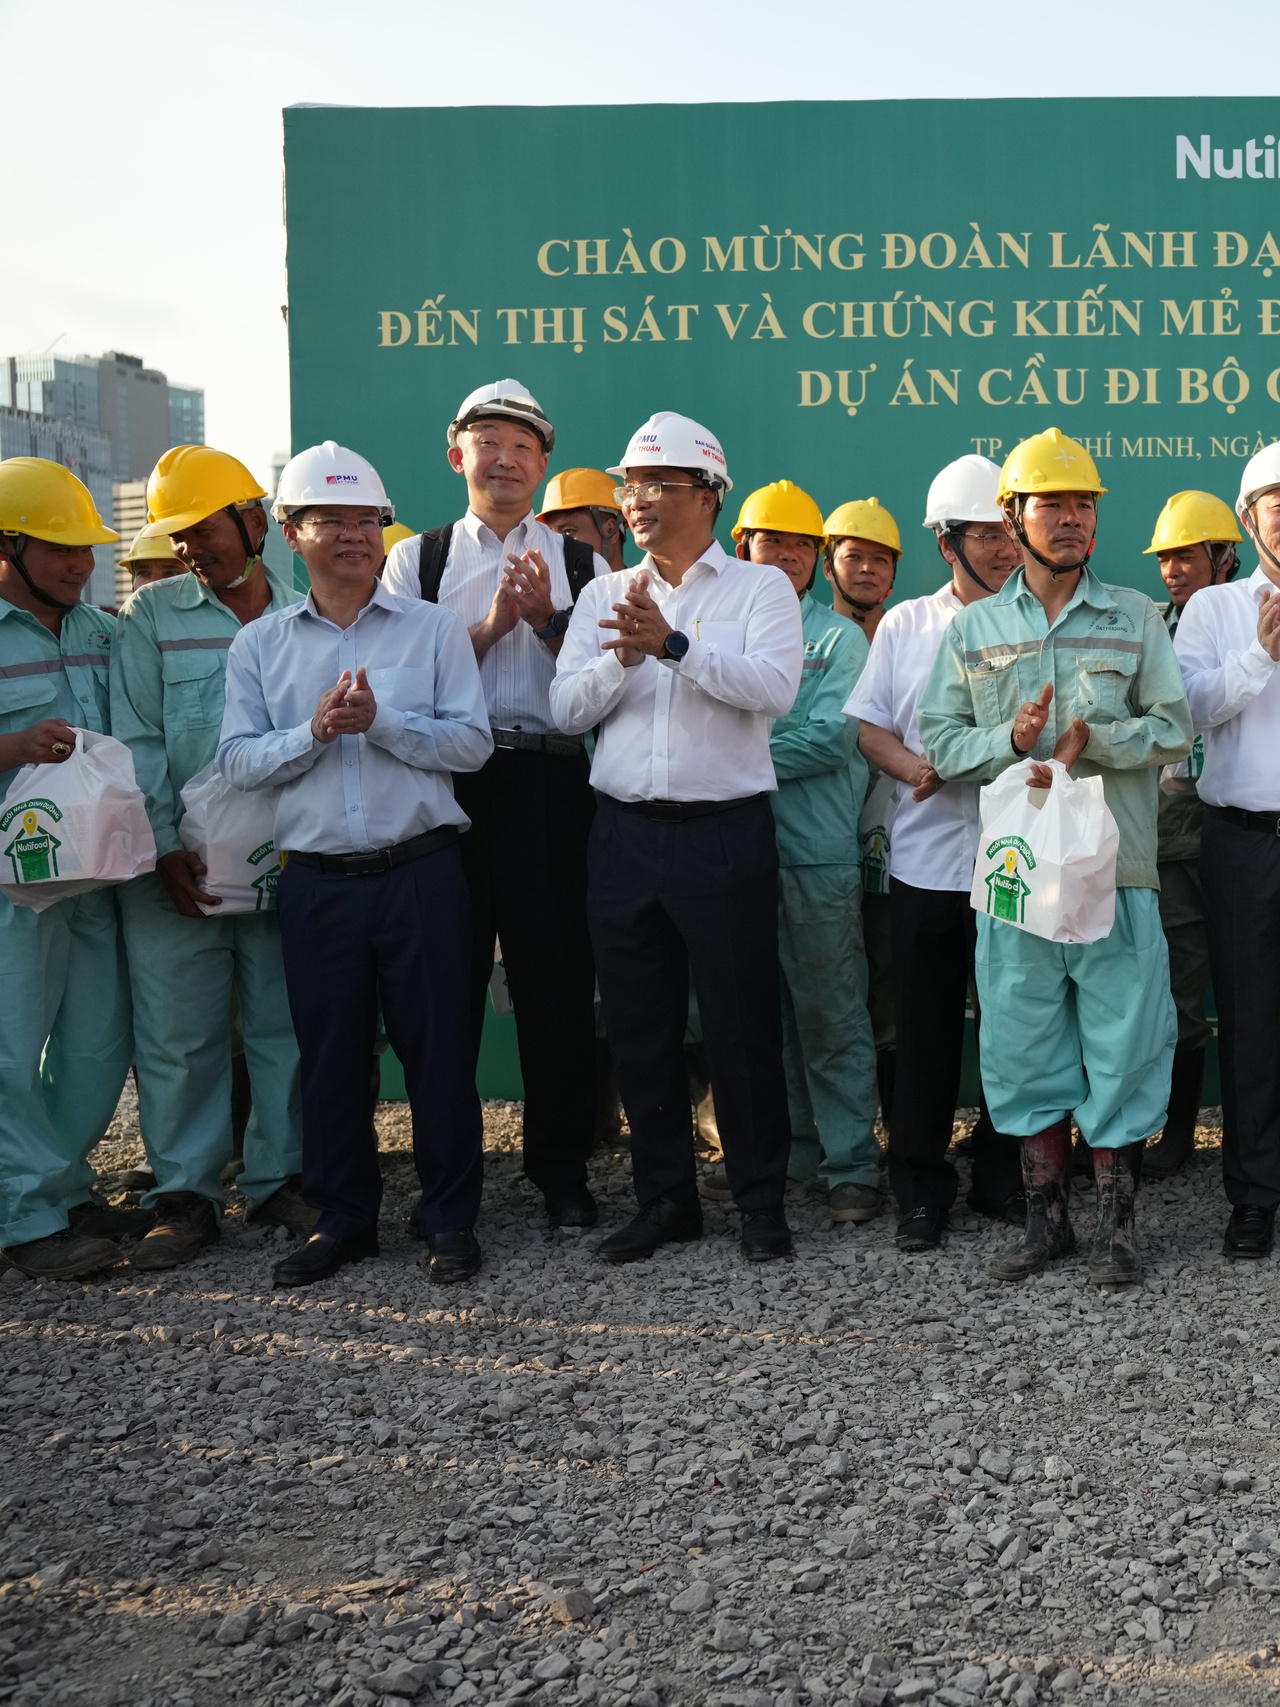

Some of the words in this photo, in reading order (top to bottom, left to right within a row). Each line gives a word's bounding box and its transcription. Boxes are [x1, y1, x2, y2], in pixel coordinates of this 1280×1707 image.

[537, 228, 686, 276] CHÀO
[702, 225, 866, 272] MỪNG
[881, 222, 1033, 269] ĐOÀN
[1048, 223, 1198, 268] LÃNH
[377, 294, 481, 346] ĐẾN
[497, 307, 587, 353] THỊ
[604, 295, 699, 342] SÁT
[714, 293, 787, 340] VÀ
[803, 291, 997, 338] CHỨNG
[1013, 284, 1144, 336] KIẾN
[1160, 288, 1241, 335] MẺ
[797, 363, 877, 416] DỰ
[889, 359, 961, 405] ÁN
[978, 353, 1088, 405] CẦU
[1104, 368, 1160, 404] ĐI
[1177, 356, 1250, 414] BỘ
[637, 435, 657, 443] PMU
[971, 437, 1008, 457] TP.
[1121, 437, 1202, 460] MINH,
[17, 838, 49, 853] Nutifood
